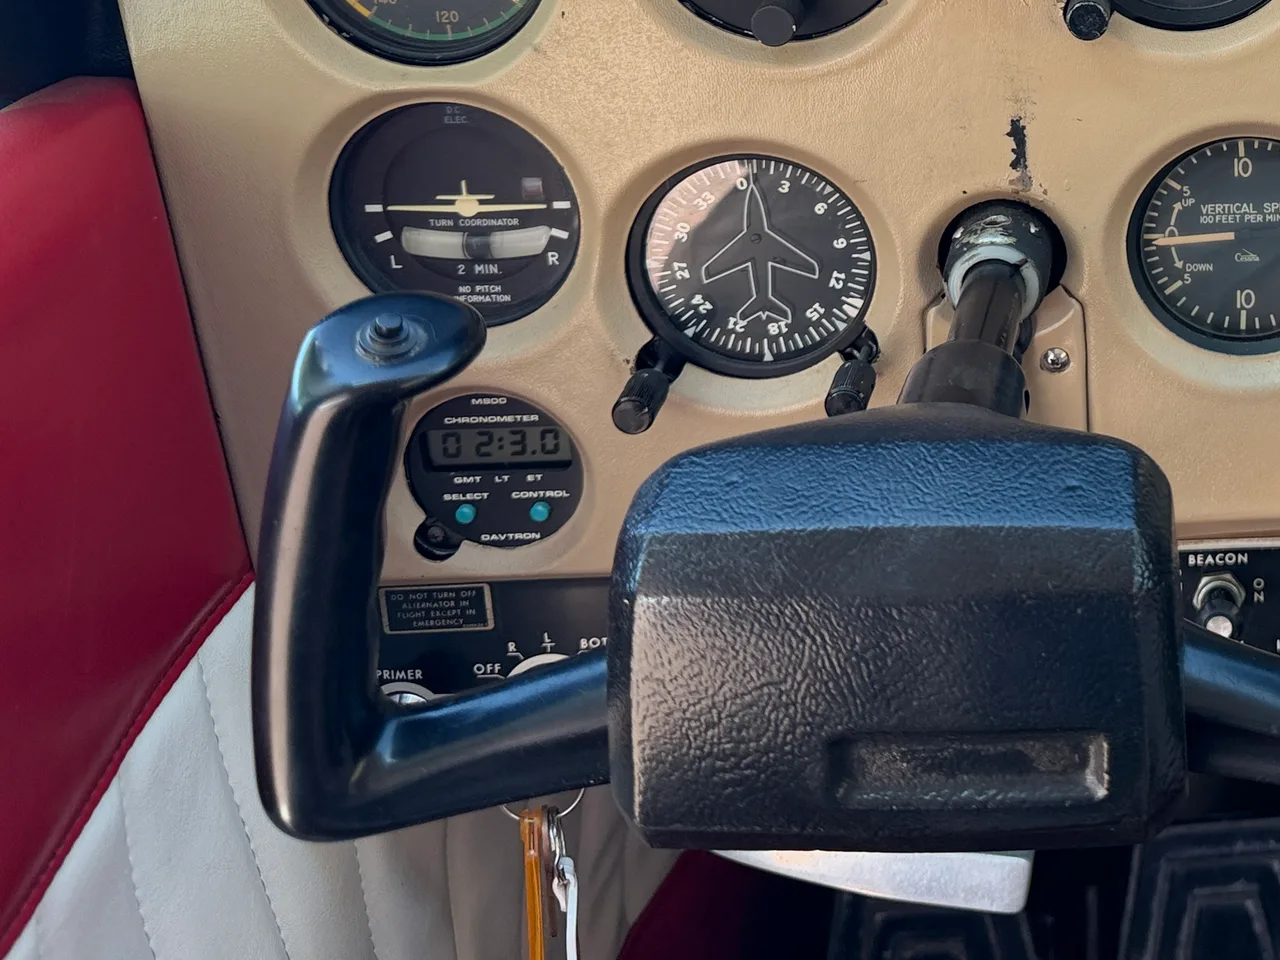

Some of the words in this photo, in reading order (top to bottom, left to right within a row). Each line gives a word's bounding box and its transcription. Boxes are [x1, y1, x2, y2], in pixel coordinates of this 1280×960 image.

[436, 11, 458, 22] 120
[1234, 158, 1252, 177] 10
[693, 192, 715, 210] 33
[1182, 198, 1195, 206] UP
[1201, 203, 1257, 214] VERTICAL
[459, 218, 519, 226] COORDINATOR
[1216, 215, 1240, 223] FEET
[457, 265, 465, 274] 2
[475, 264, 503, 274] MIN.
[1186, 264, 1213, 272] DOWN
[444, 414, 538, 424] CHRONOMETER
[454, 476, 481, 484] GMT
[443, 493, 489, 501] SELECT
[511, 490, 569, 499] CONTROL
[481, 533, 540, 541] DAVTRON
[1188, 553, 1248, 566] BEACON
[402, 600, 455, 609] ALTERNATOR
[413, 618, 463, 627] EMERGENCY
[473, 664, 501, 673] OFF
[376, 669, 422, 680] PRIMER
